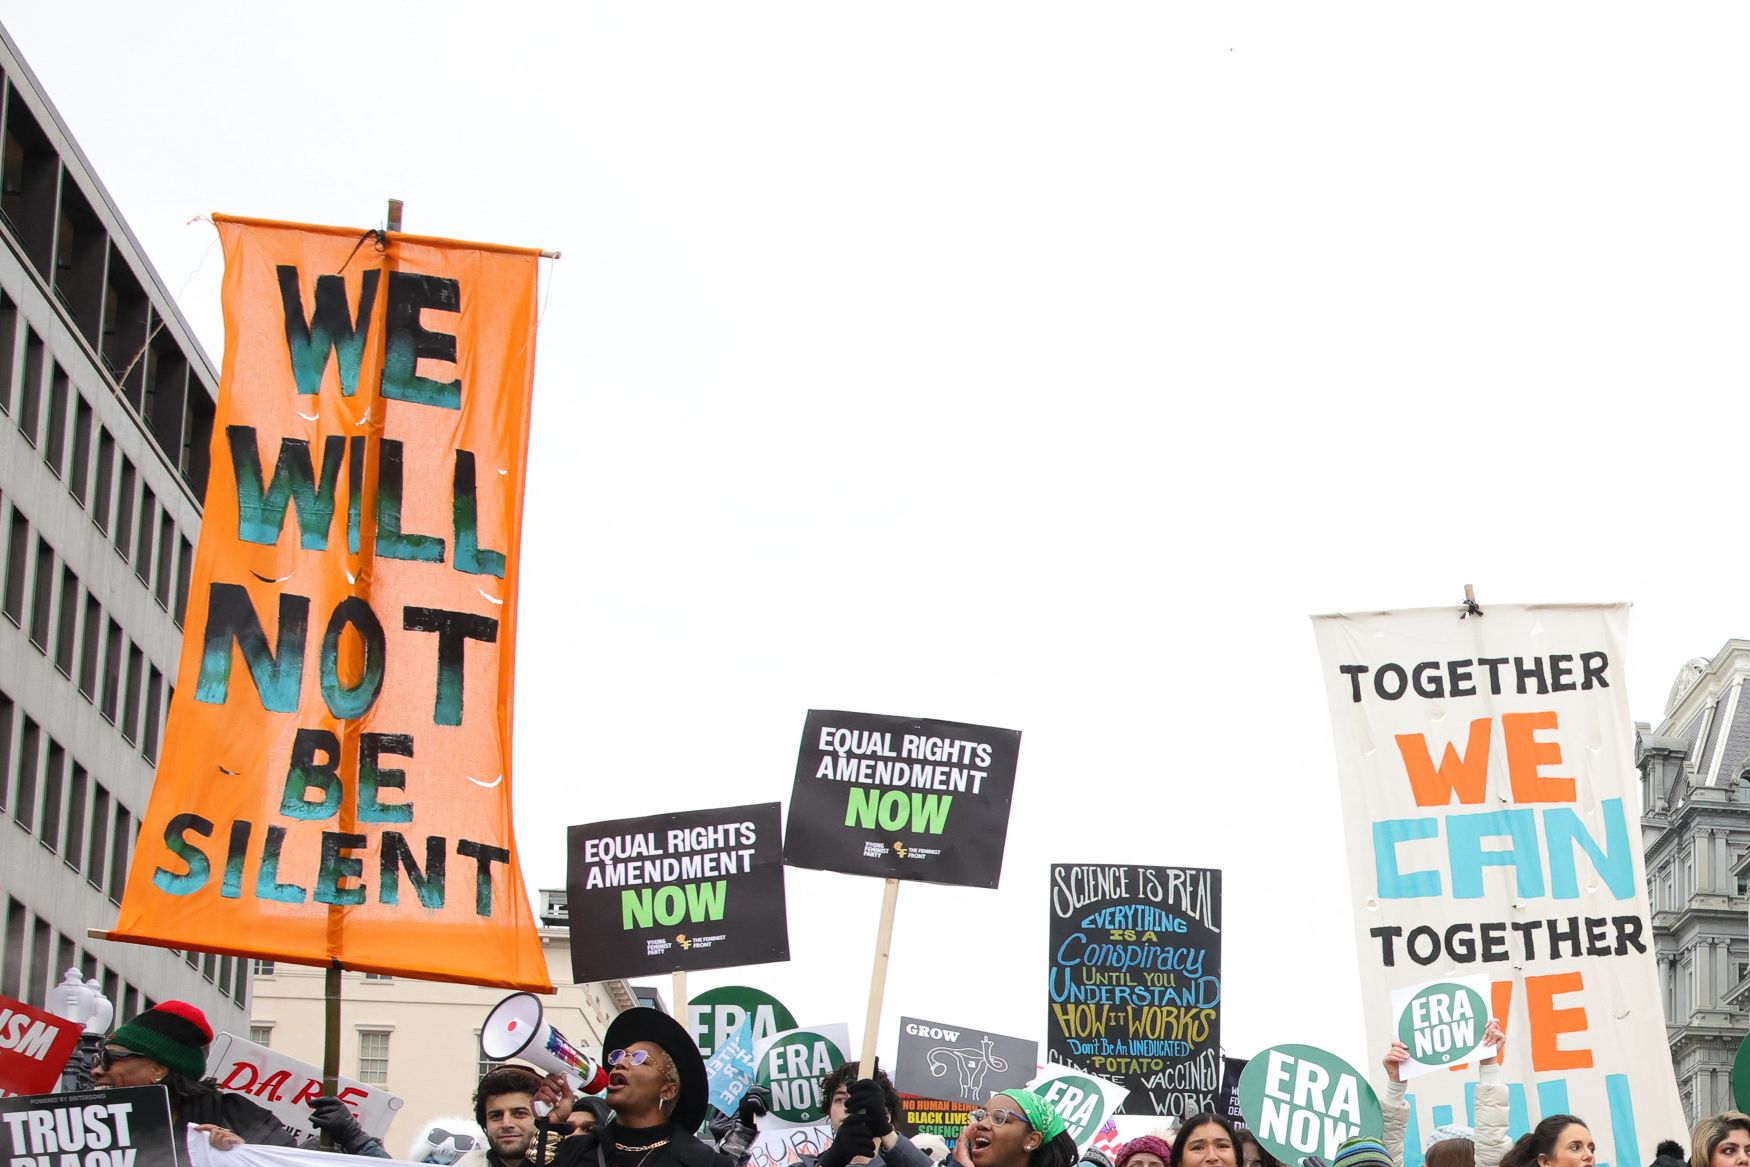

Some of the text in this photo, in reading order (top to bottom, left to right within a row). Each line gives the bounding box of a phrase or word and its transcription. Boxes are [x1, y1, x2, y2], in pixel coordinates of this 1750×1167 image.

[276, 265, 461, 410] WE
[226, 425, 506, 579] WILL
[195, 583, 498, 727] NOT
[1340, 651, 1610, 703] TOGETHER
[818, 726, 992, 767] EQUAL RIGHTS
[1394, 711, 1577, 807] WE
[280, 728, 414, 823] BE
[816, 755, 988, 795] AMENDMENT
[844, 786, 953, 835] NOW
[152, 813, 510, 917] SILENT
[585, 821, 756, 865] EQUAL RIGHTS
[1372, 797, 1636, 900] CAN
[586, 849, 755, 889] AMENDMENT
[621, 879, 727, 931] NOW
[1053, 866, 1220, 933] SCIENCE IS REAL
[1081, 904, 1188, 933] EVERYTHING
[1057, 932, 1205, 978] Conspiracy
[1110, 929, 1158, 942] IS A
[1370, 915, 1647, 967] TOGETHER
[1050, 967, 1221, 1009] UNDERSTAND
[1082, 967, 1176, 987] UNTIL YOU
[688, 1004, 778, 1057] ERA
[1052, 1003, 1216, 1050] HOW IT WORKS
[1411, 989, 1474, 1030] ERA
[906, 1023, 960, 1043] GROW
[1067, 1039, 1191, 1056] Don't Be An UNEDUCATED
[1414, 1018, 1474, 1058] NOW
[769, 1040, 834, 1081] ERA
[1091, 1056, 1163, 1074] POTATO
[1141, 1048, 1219, 1091] VACCINES
[902, 1100, 915, 1110] NO
[917, 1100, 949, 1111] HUMAN
[1264, 1049, 1361, 1125] ERA
[2, 1103, 133, 1156] TRUST
[908, 1112, 972, 1124] BLACK LIVES
[918, 1125, 963, 1138] SCIENC
[1258, 1097, 1361, 1162] NOW
